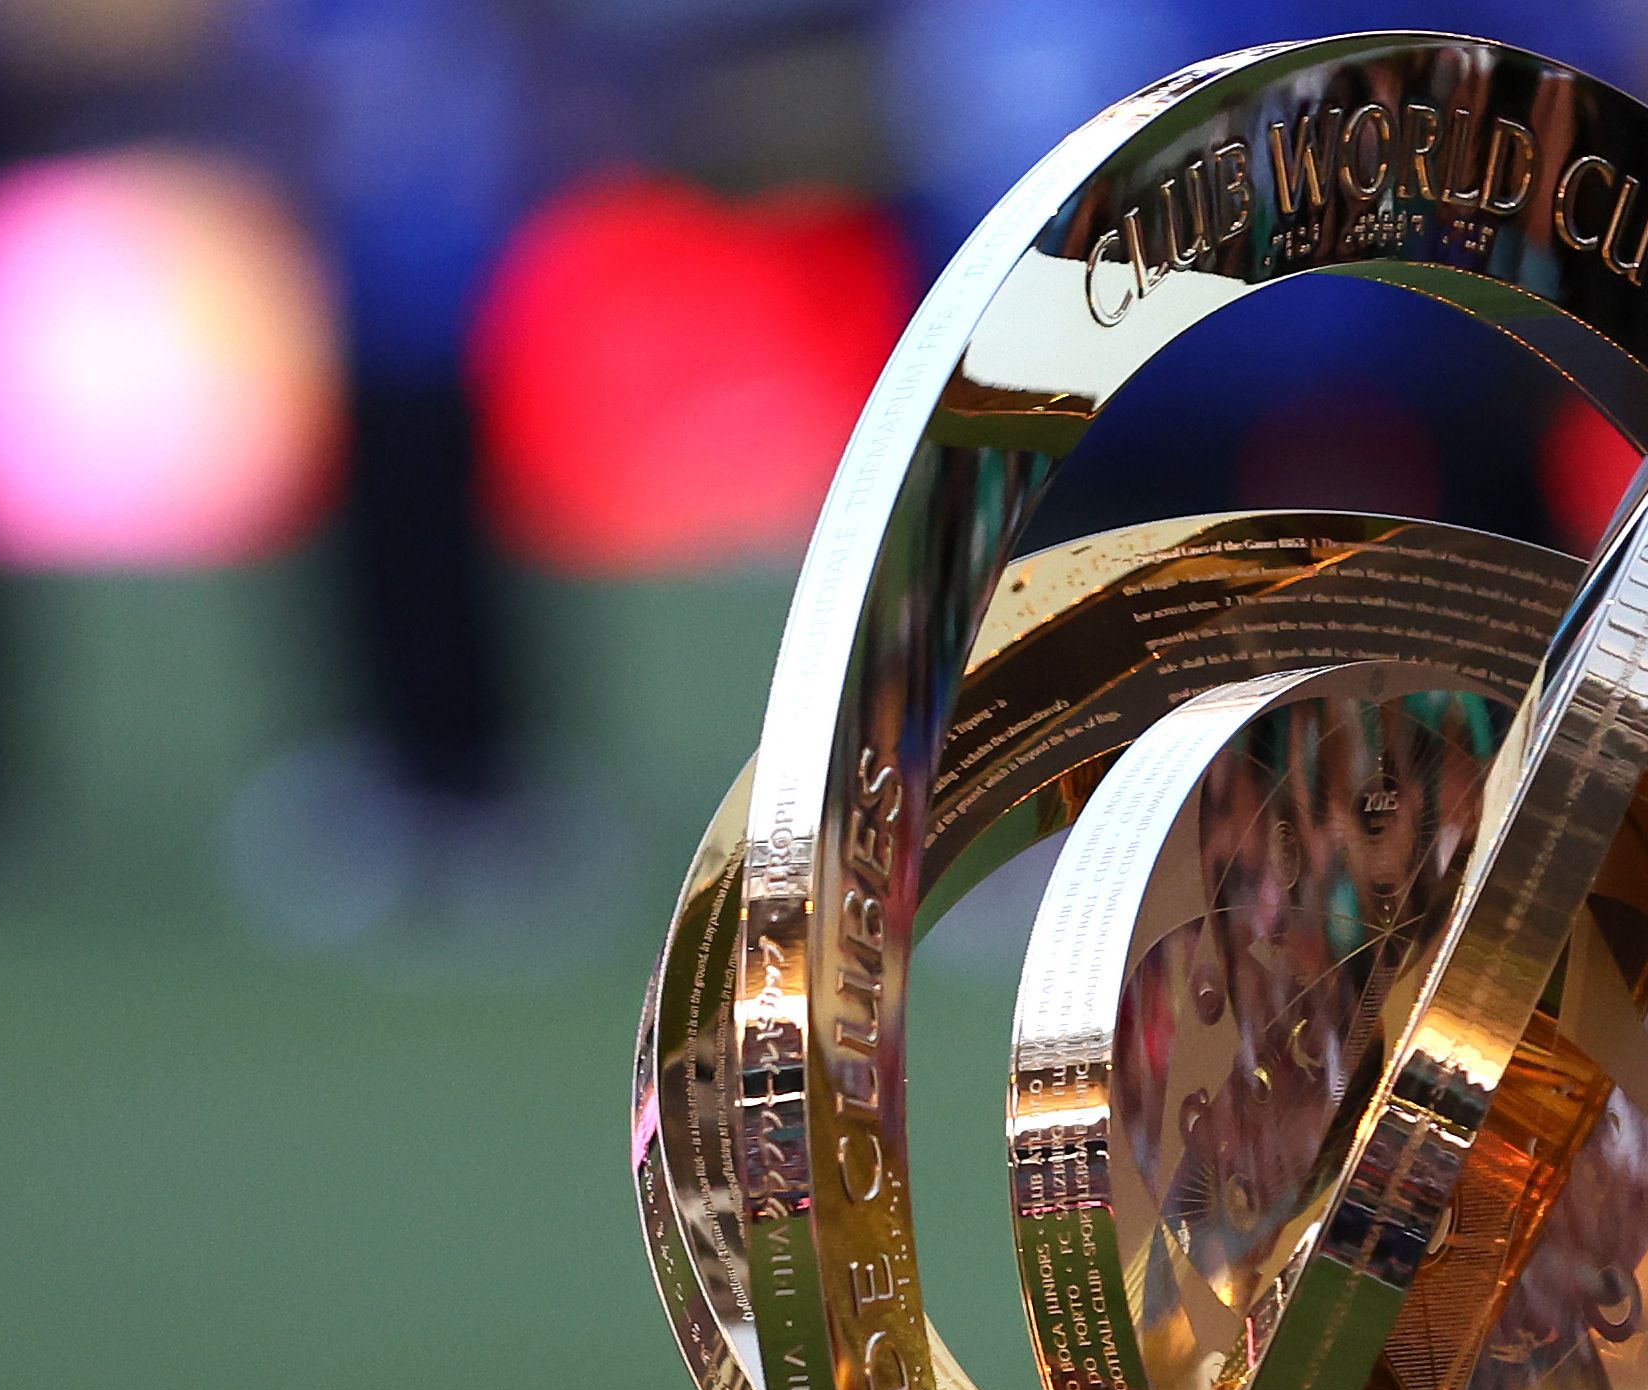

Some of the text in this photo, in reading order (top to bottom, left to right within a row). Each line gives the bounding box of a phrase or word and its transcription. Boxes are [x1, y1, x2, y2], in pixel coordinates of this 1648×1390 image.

[1085, 142, 1249, 328] CLUB
[1269, 103, 1535, 216] WORLD
[835, 744, 905, 1203] CLUBES
[1029, 1172, 1045, 1220] CLUB
[1074, 1138, 1091, 1200] LISBOA
[1056, 1230, 1074, 1256] FC
[1035, 1241, 1065, 1317] JUNIORS
[1086, 1267, 1109, 1313] CLUB
[1065, 1283, 1093, 1348] PORTO
[1050, 1320, 1076, 1373] BOCA
[1082, 1356, 1103, 1387] DO
